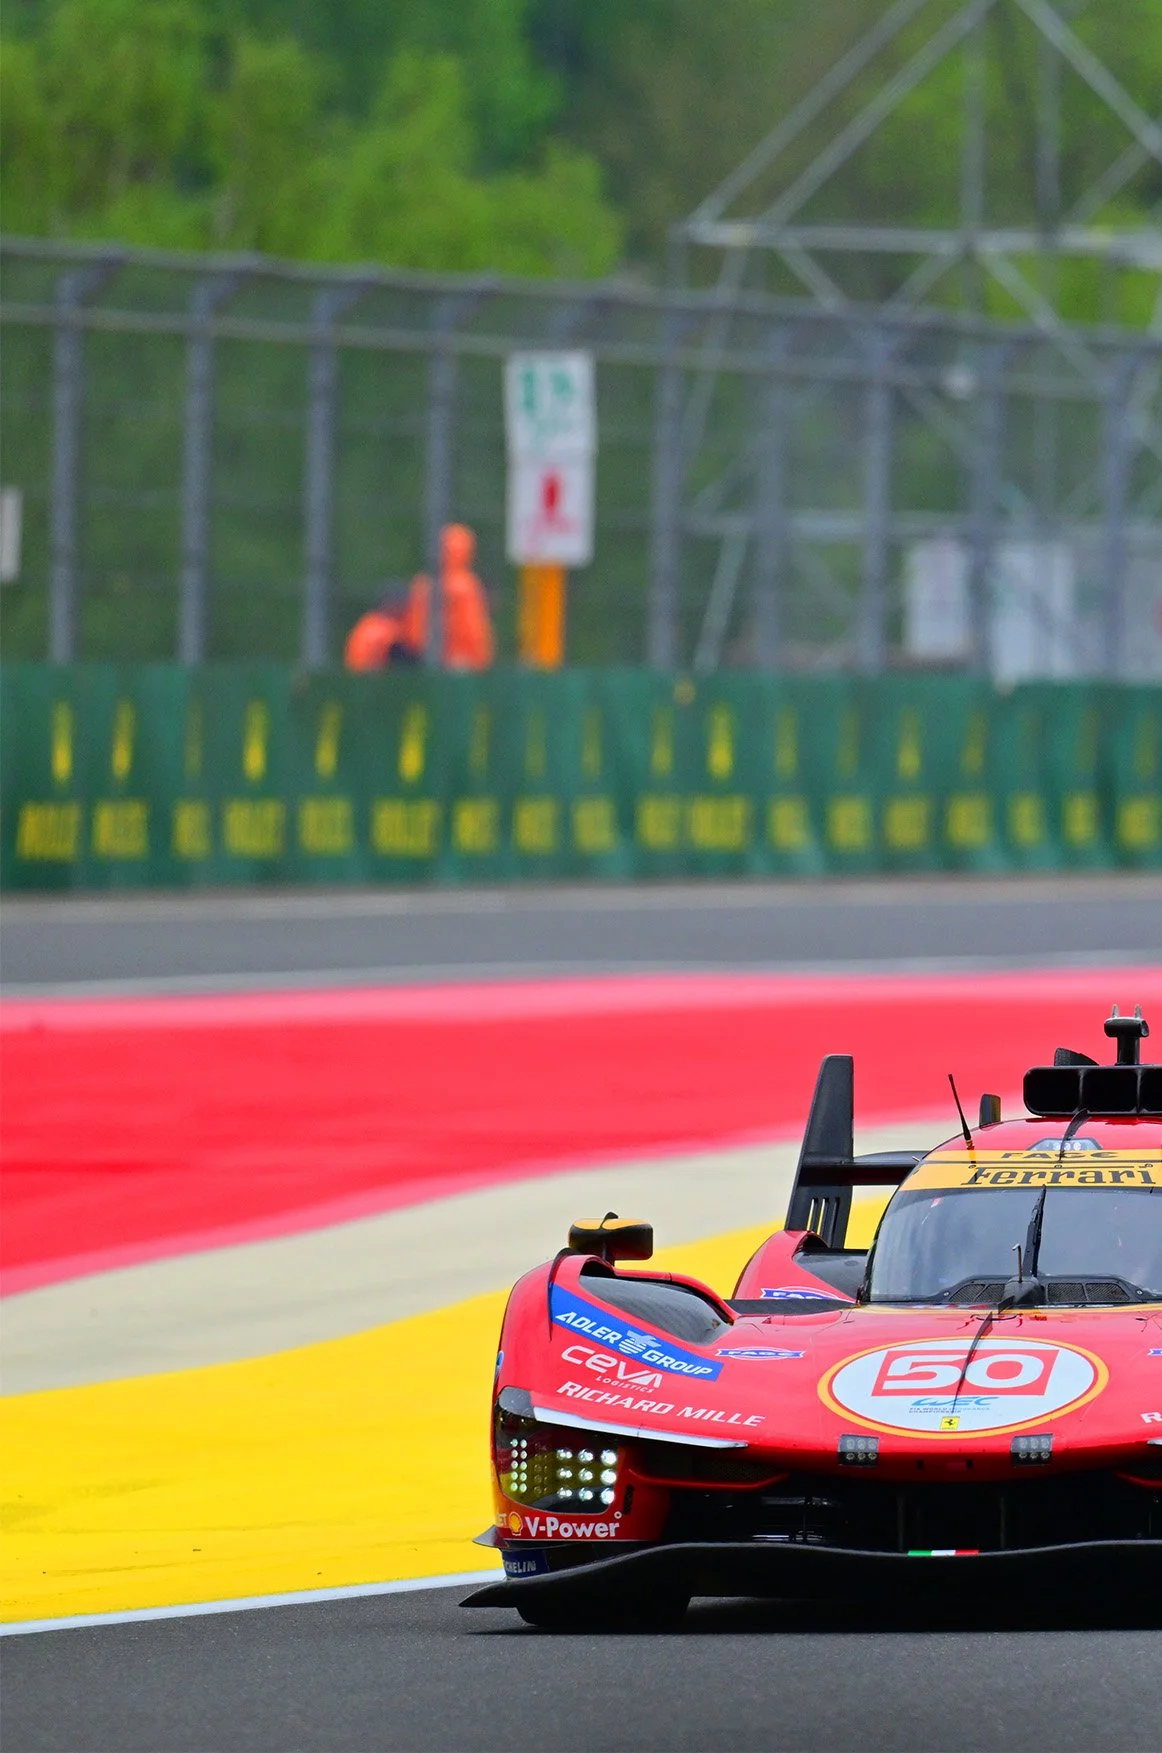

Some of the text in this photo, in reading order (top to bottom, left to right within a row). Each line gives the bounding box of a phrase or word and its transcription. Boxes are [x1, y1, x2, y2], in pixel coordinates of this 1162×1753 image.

[960, 1164, 1156, 1186] Ferrari
[555, 1311, 713, 1375] ADLER GROUP
[882, 1354, 1045, 1389] 50
[596, 1375, 654, 1393] LOGISTICS
[556, 1381, 766, 1427] RICHARD MILLE
[524, 1516, 620, 1537] V-Power
[504, 1560, 537, 1573] CHELIN
